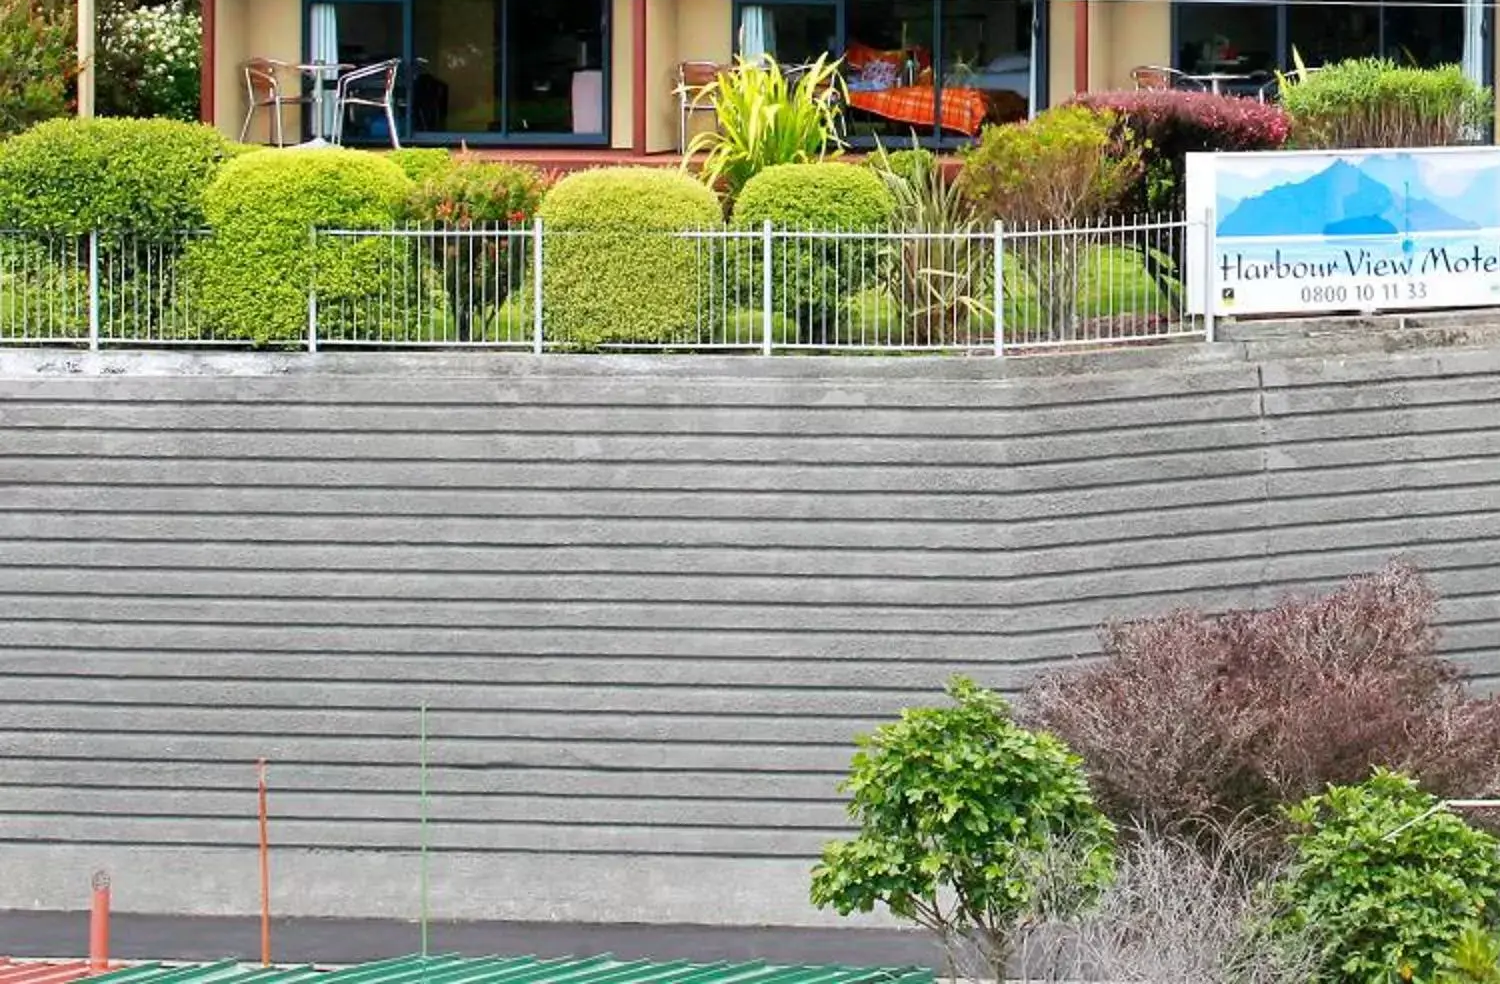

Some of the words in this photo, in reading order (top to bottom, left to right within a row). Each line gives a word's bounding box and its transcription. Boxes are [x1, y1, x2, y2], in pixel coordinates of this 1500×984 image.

[1220, 248, 1339, 281] Harbour
[1344, 247, 1413, 276] View
[1301, 284, 1347, 303] 0800
[1355, 283, 1375, 302] 10
[1382, 283, 1398, 301] 11
[1407, 281, 1427, 299] 33
